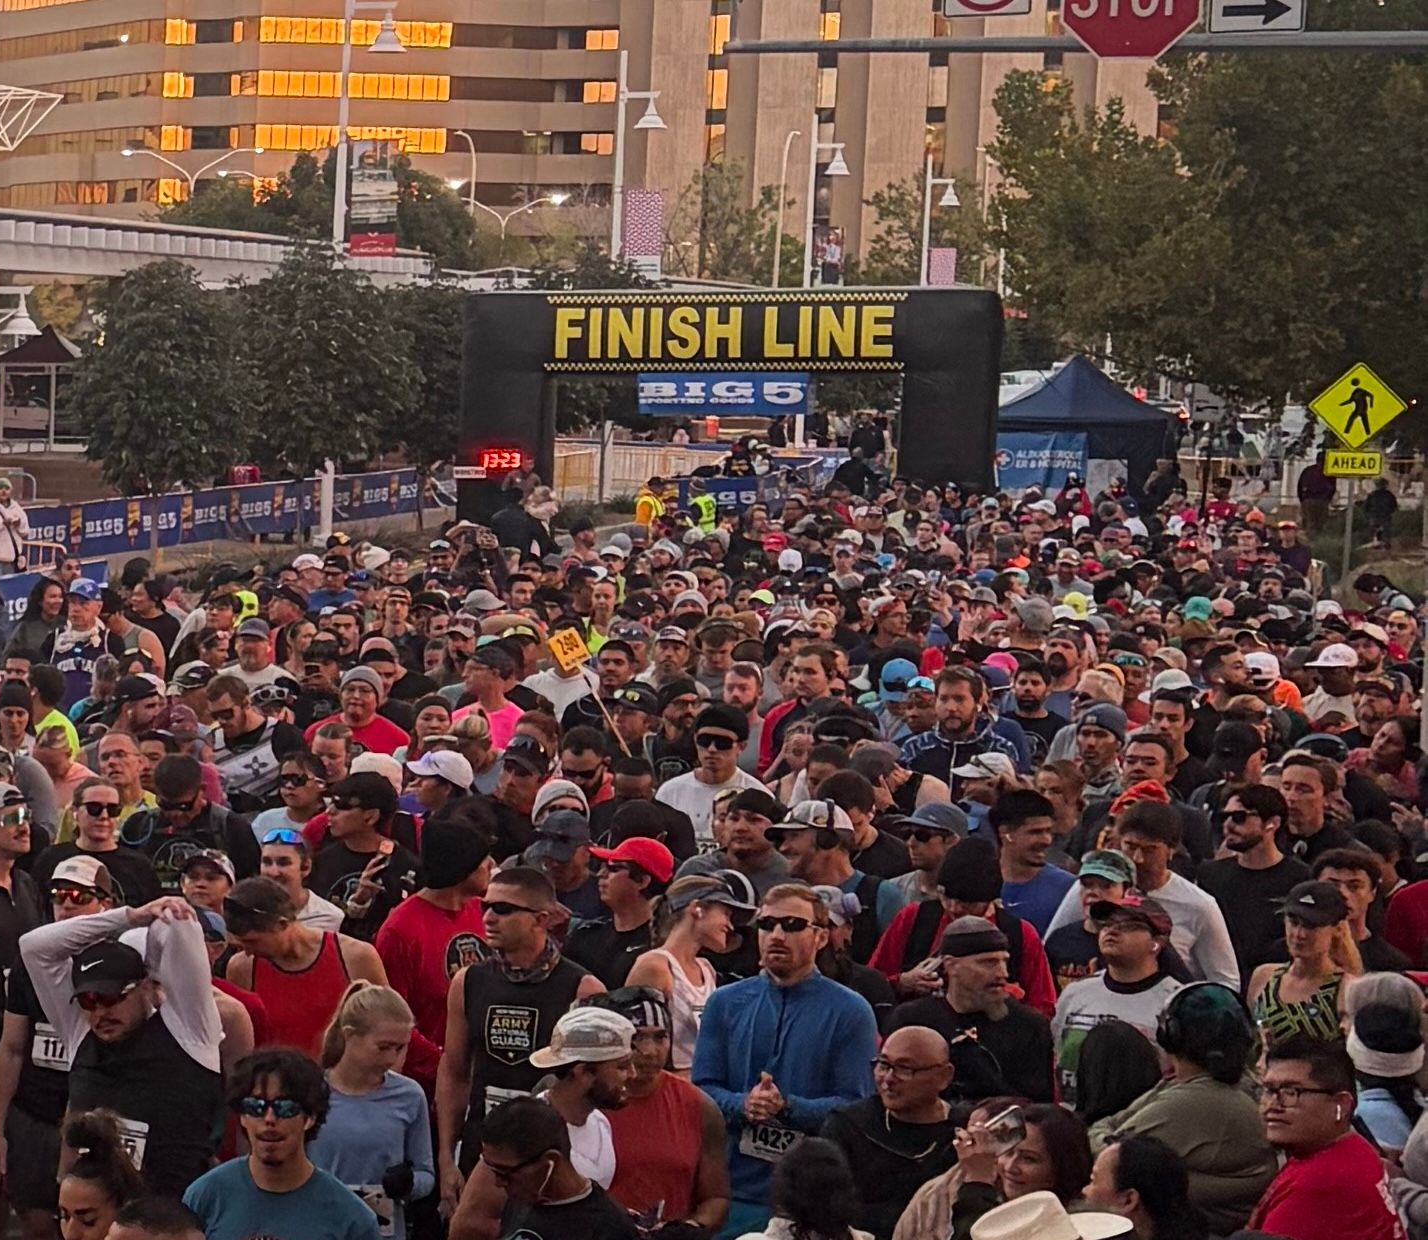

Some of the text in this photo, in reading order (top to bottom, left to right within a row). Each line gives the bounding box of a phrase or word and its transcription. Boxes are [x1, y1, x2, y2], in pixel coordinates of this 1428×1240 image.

[554, 305, 894, 359] FINISH LINE
[639, 381, 804, 404] BIG 5
[1331, 458, 1377, 470] AHEAD
[491, 1018, 530, 1029] ARMY
[490, 1035, 530, 1048] GUARD
[751, 1127, 795, 1150] 1423
